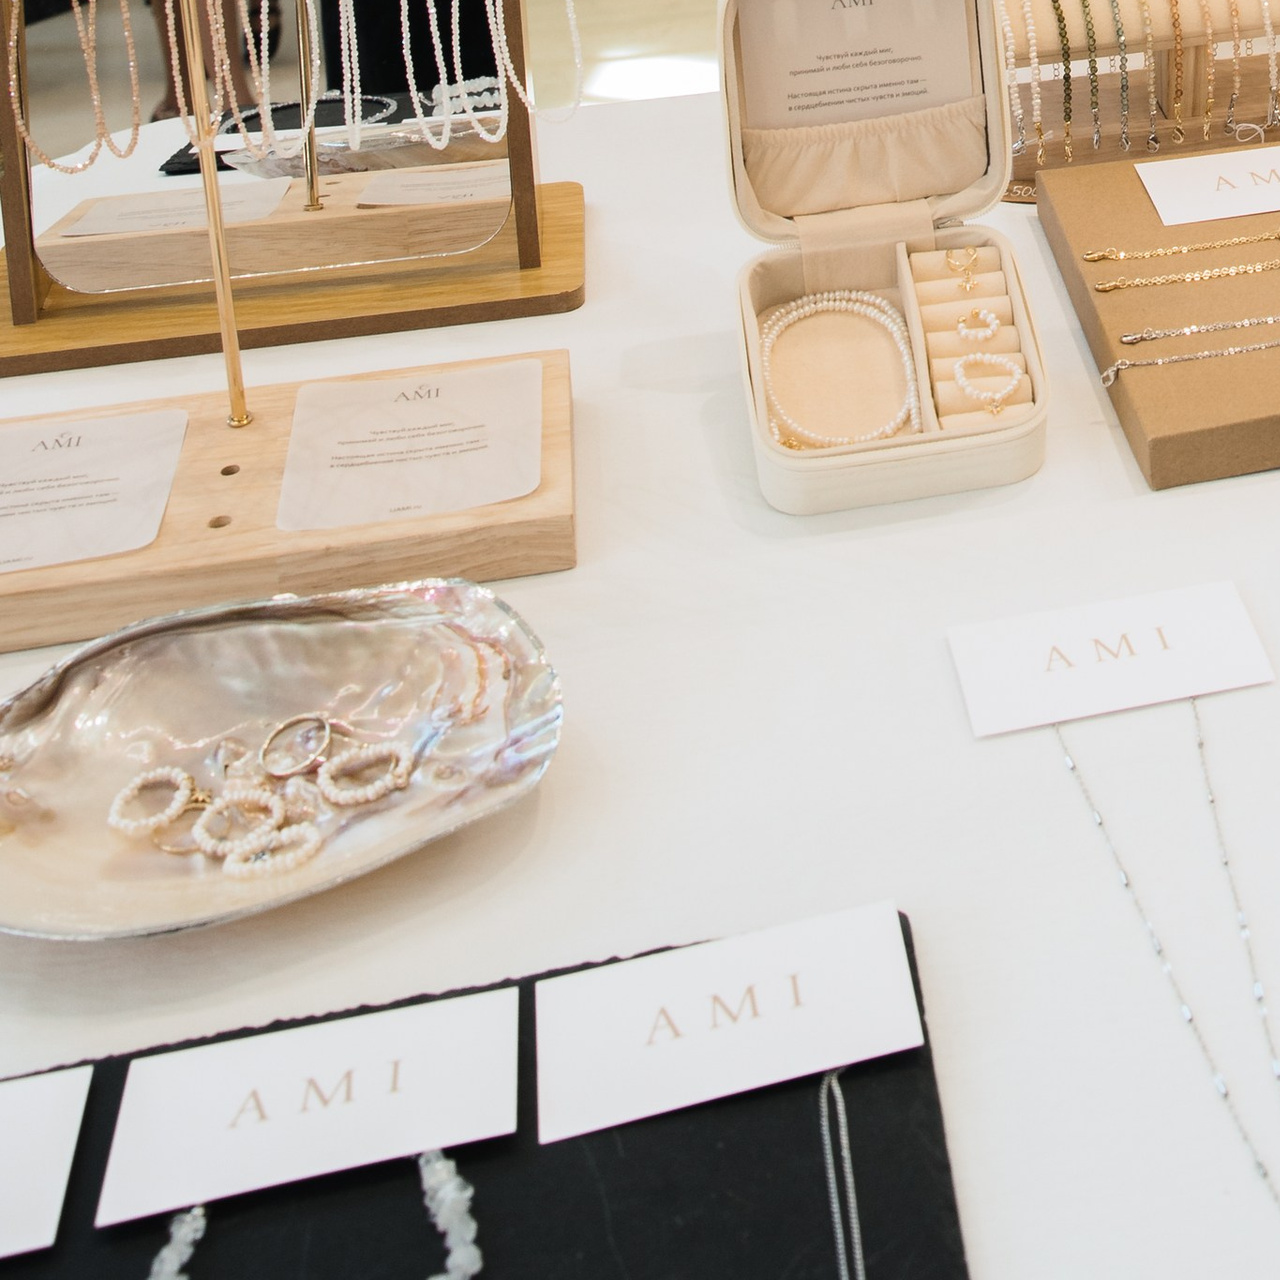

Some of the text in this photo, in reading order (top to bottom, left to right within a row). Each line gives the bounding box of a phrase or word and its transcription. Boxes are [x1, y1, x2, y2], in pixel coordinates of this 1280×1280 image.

[850, 48, 878, 57] каждый
[832, 62, 851, 71] люби
[852, 59, 868, 69] себя
[787, 88, 827, 100] Настоящая
[828, 86, 852, 95] истина
[906, 77, 919, 85] там
[393, 387, 441, 403] AMI
[32, 435, 82, 452] AMI
[1044, 625, 1172, 673] AMI
[644, 973, 804, 1047] AMI
[228, 1059, 402, 1130] AMI
